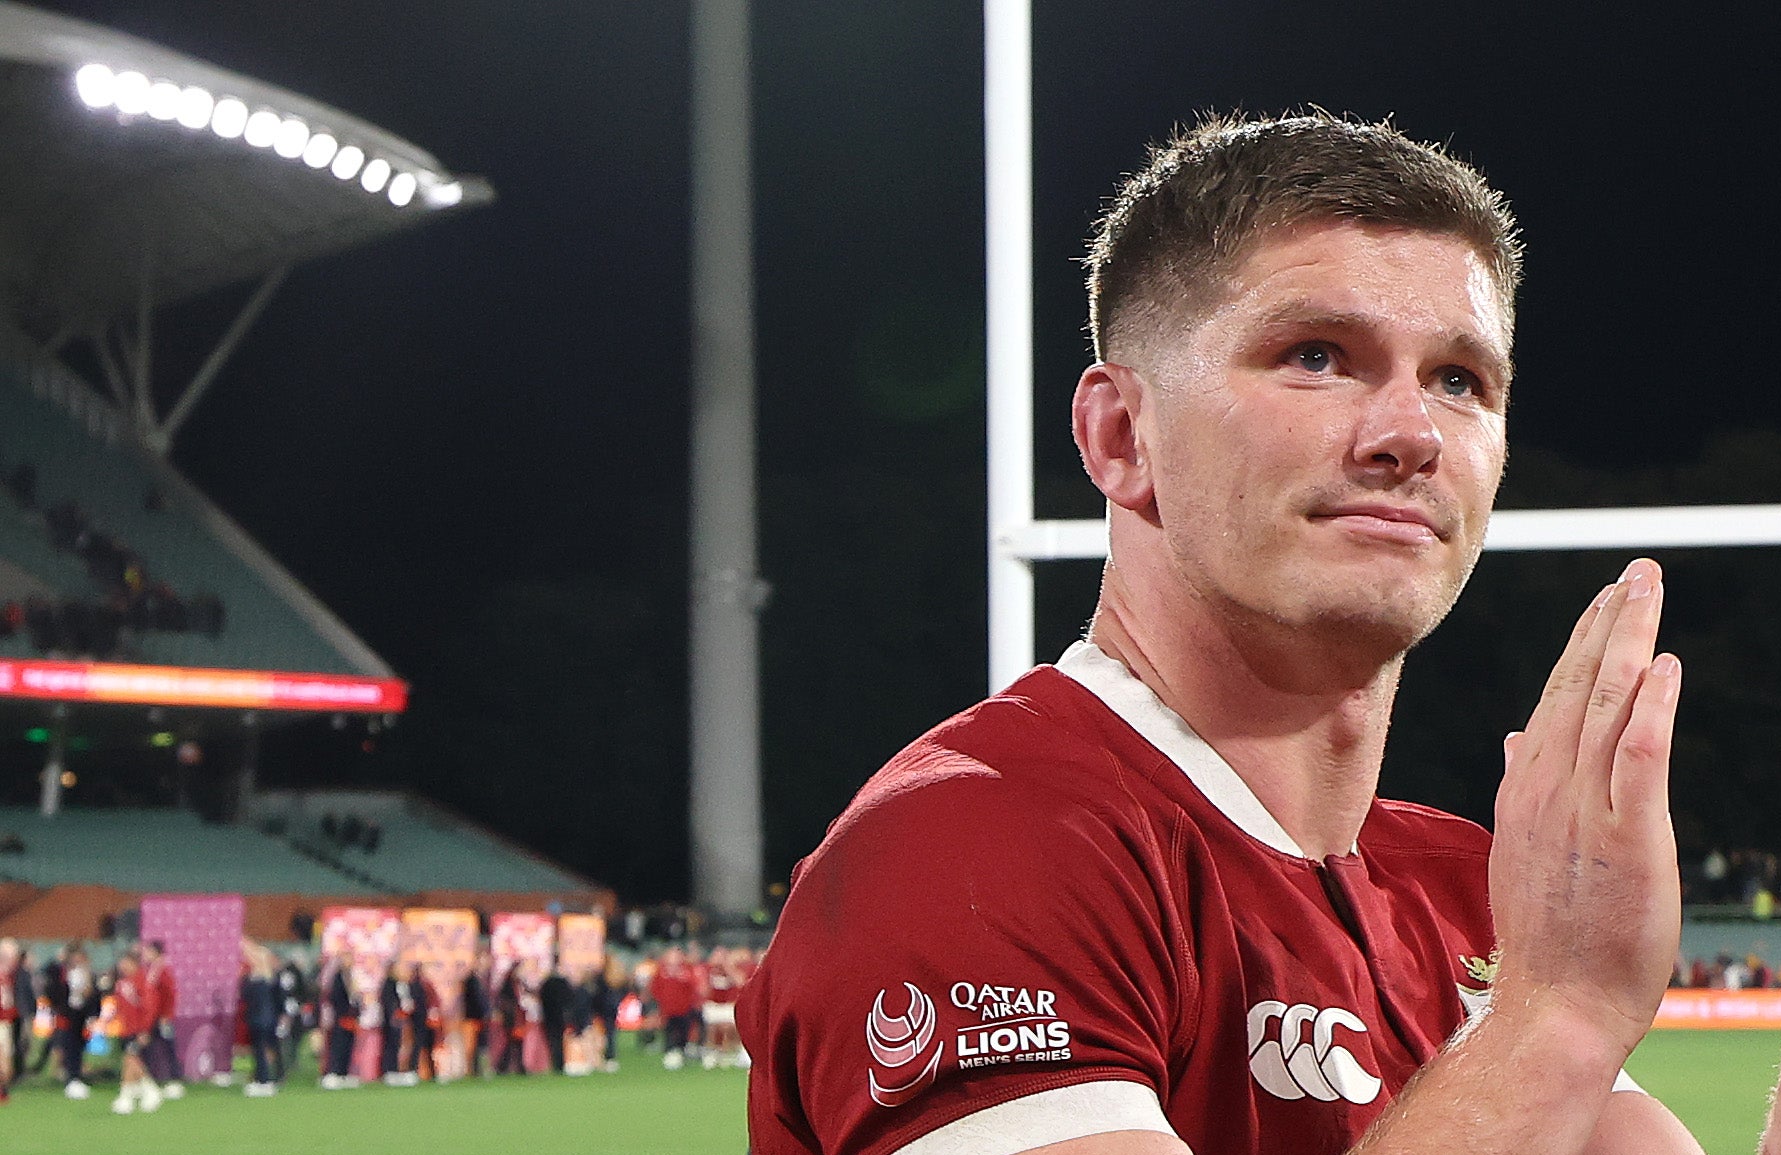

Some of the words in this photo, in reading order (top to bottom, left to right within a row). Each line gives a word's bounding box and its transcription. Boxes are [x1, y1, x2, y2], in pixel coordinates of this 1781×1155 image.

[950, 982, 1057, 1016] QATAR
[957, 1021, 1070, 1057] LIONS
[958, 1054, 1011, 1070] MEN'S
[1014, 1048, 1072, 1063] SERIES
